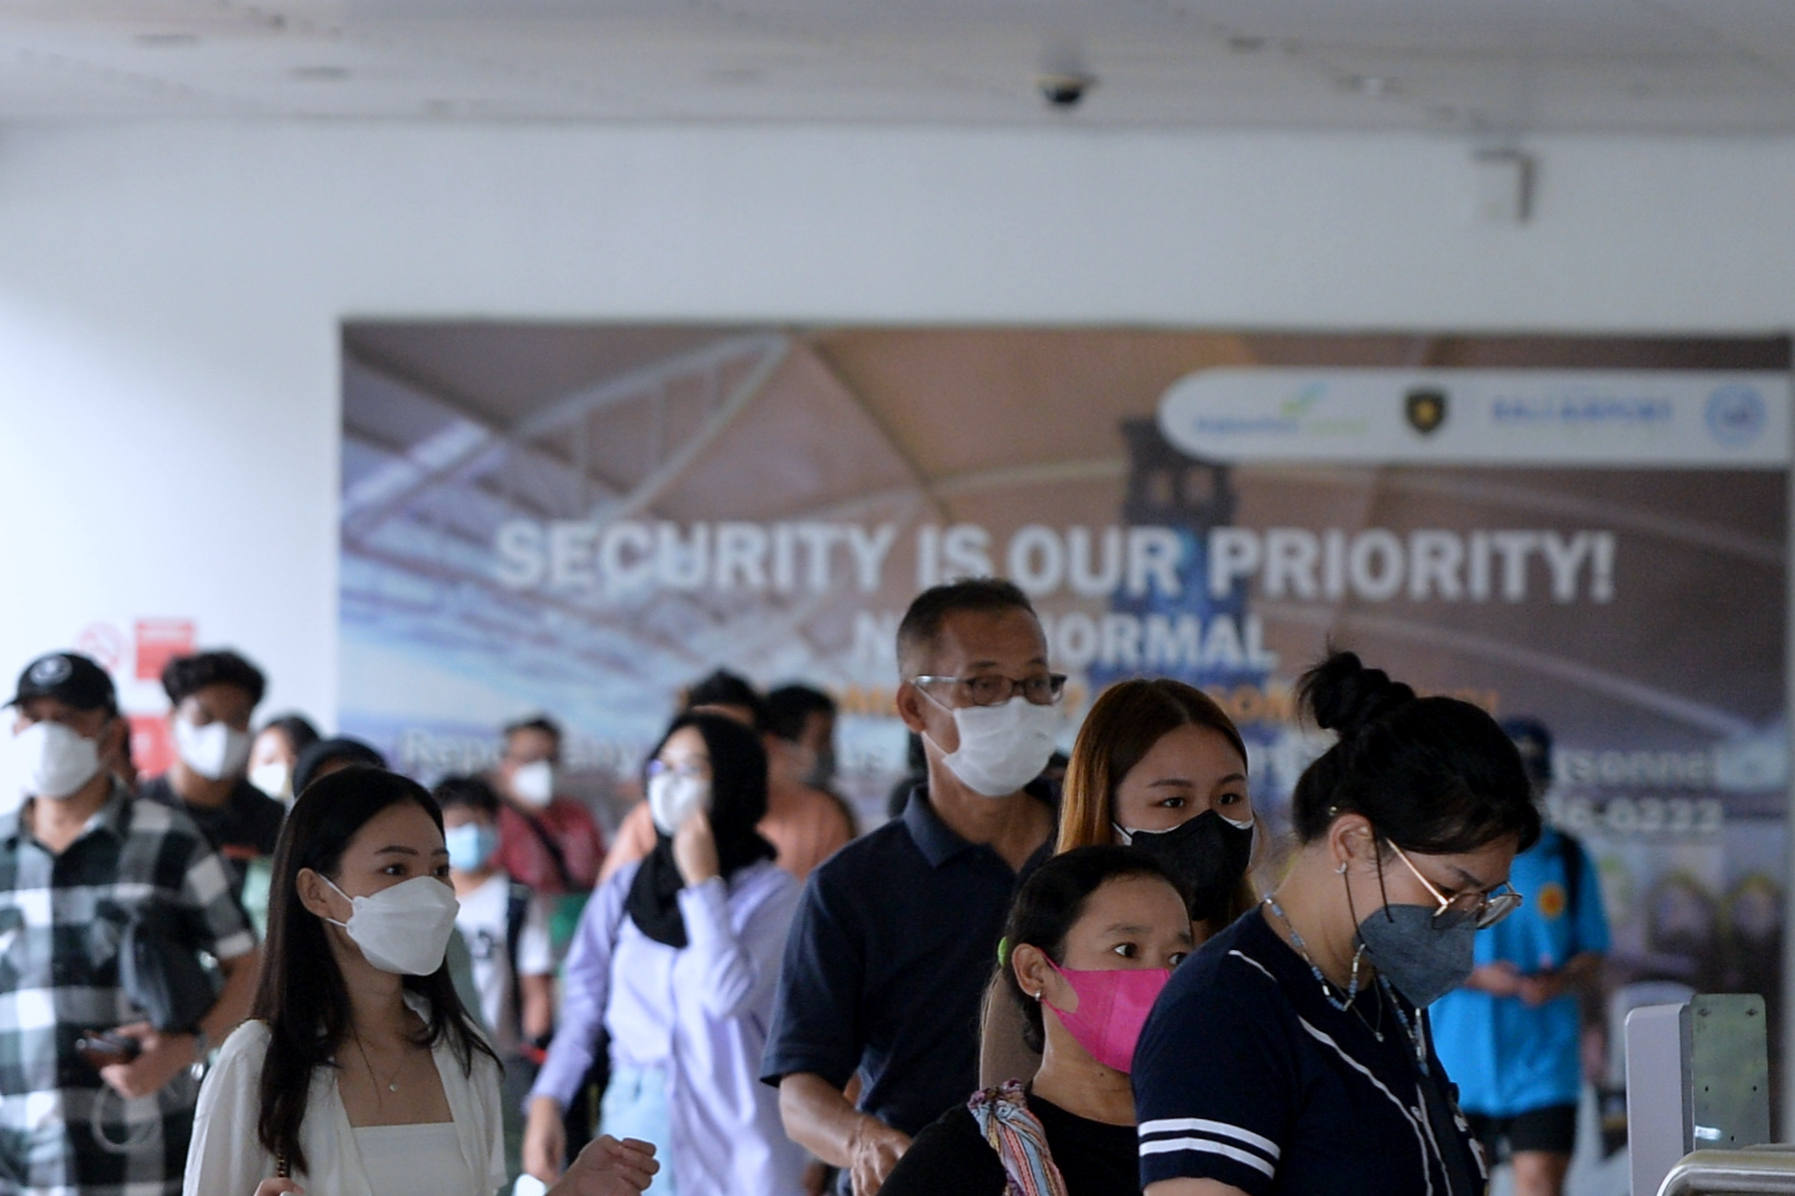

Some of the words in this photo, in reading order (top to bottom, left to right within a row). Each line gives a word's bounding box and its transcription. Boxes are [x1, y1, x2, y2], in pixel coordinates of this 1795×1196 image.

[496, 518, 896, 592] SECURITY
[918, 524, 996, 588] IS
[1009, 524, 1182, 596] OUR
[1209, 526, 1616, 602] PRIORITY!
